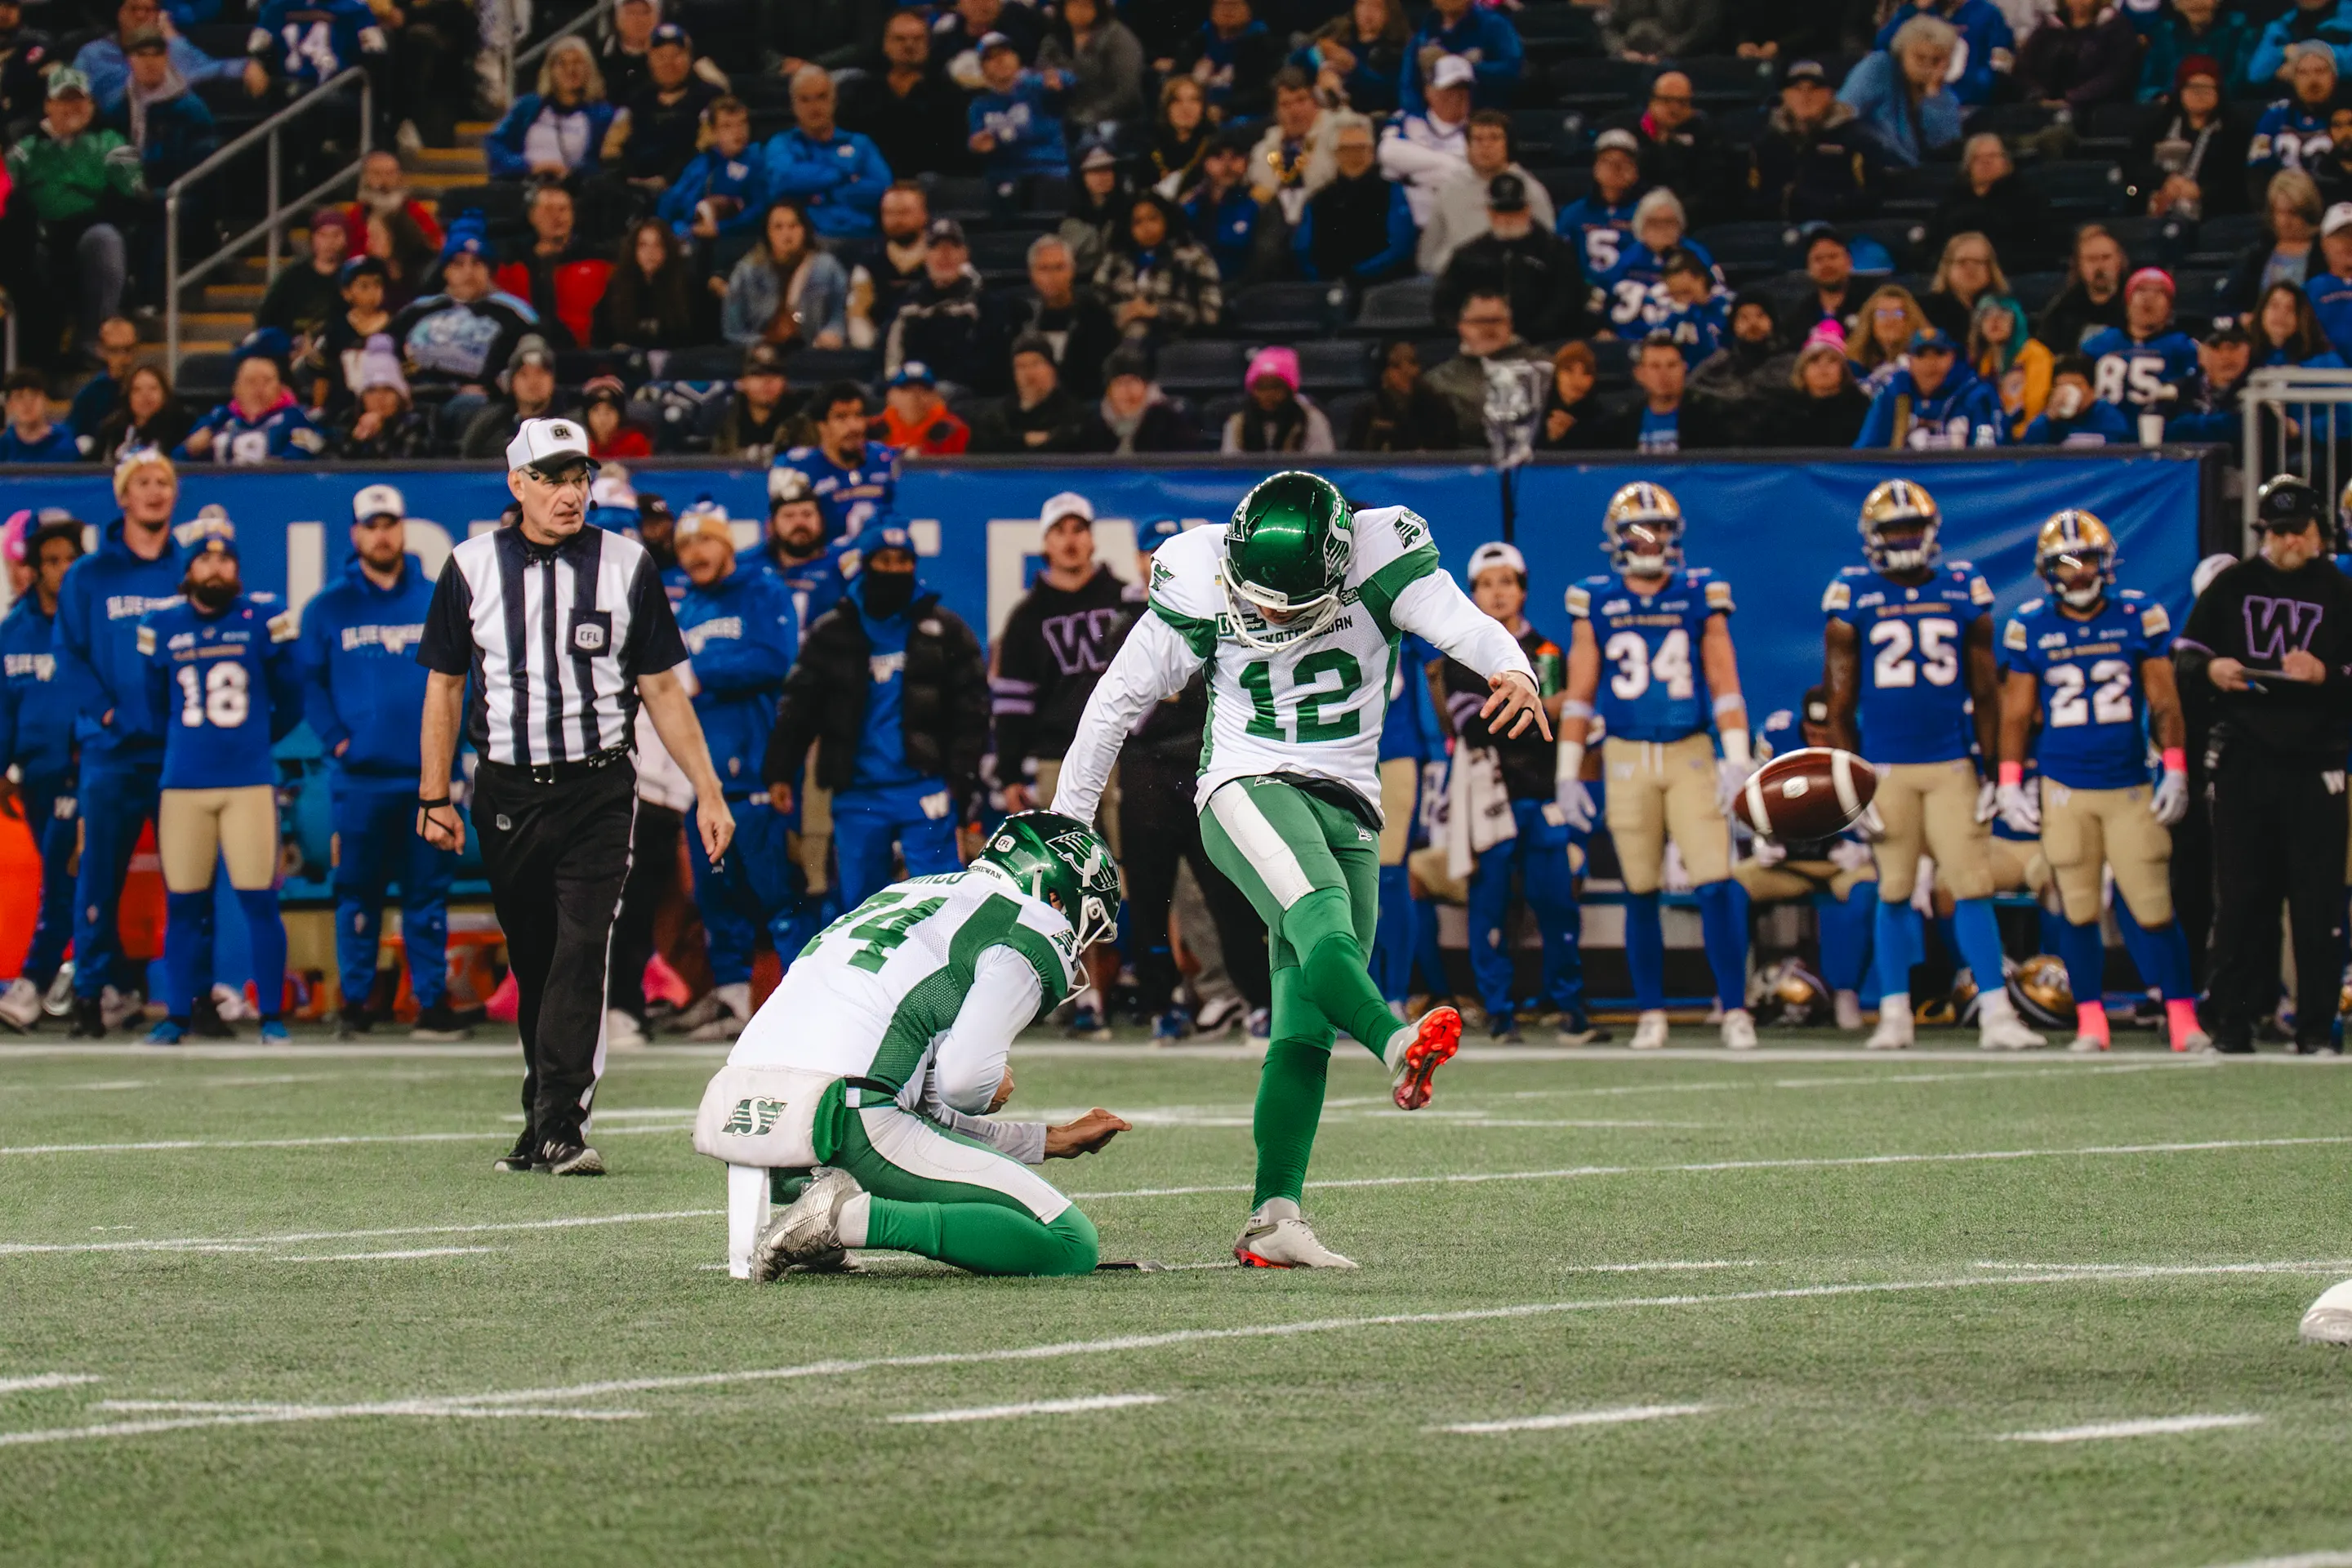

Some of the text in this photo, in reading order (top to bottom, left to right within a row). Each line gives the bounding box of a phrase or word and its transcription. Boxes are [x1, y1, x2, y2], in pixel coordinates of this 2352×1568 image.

[1586, 228, 1620, 273] 5
[580, 630, 599, 643] CFL
[1869, 618, 1958, 688] 25
[2243, 595, 2323, 658] W
[176, 661, 250, 728] 18
[1239, 648, 1363, 743] 12
[1605, 628, 1694, 700] 34
[2044, 660, 2133, 728] 22
[997, 838, 1011, 849] CFL
